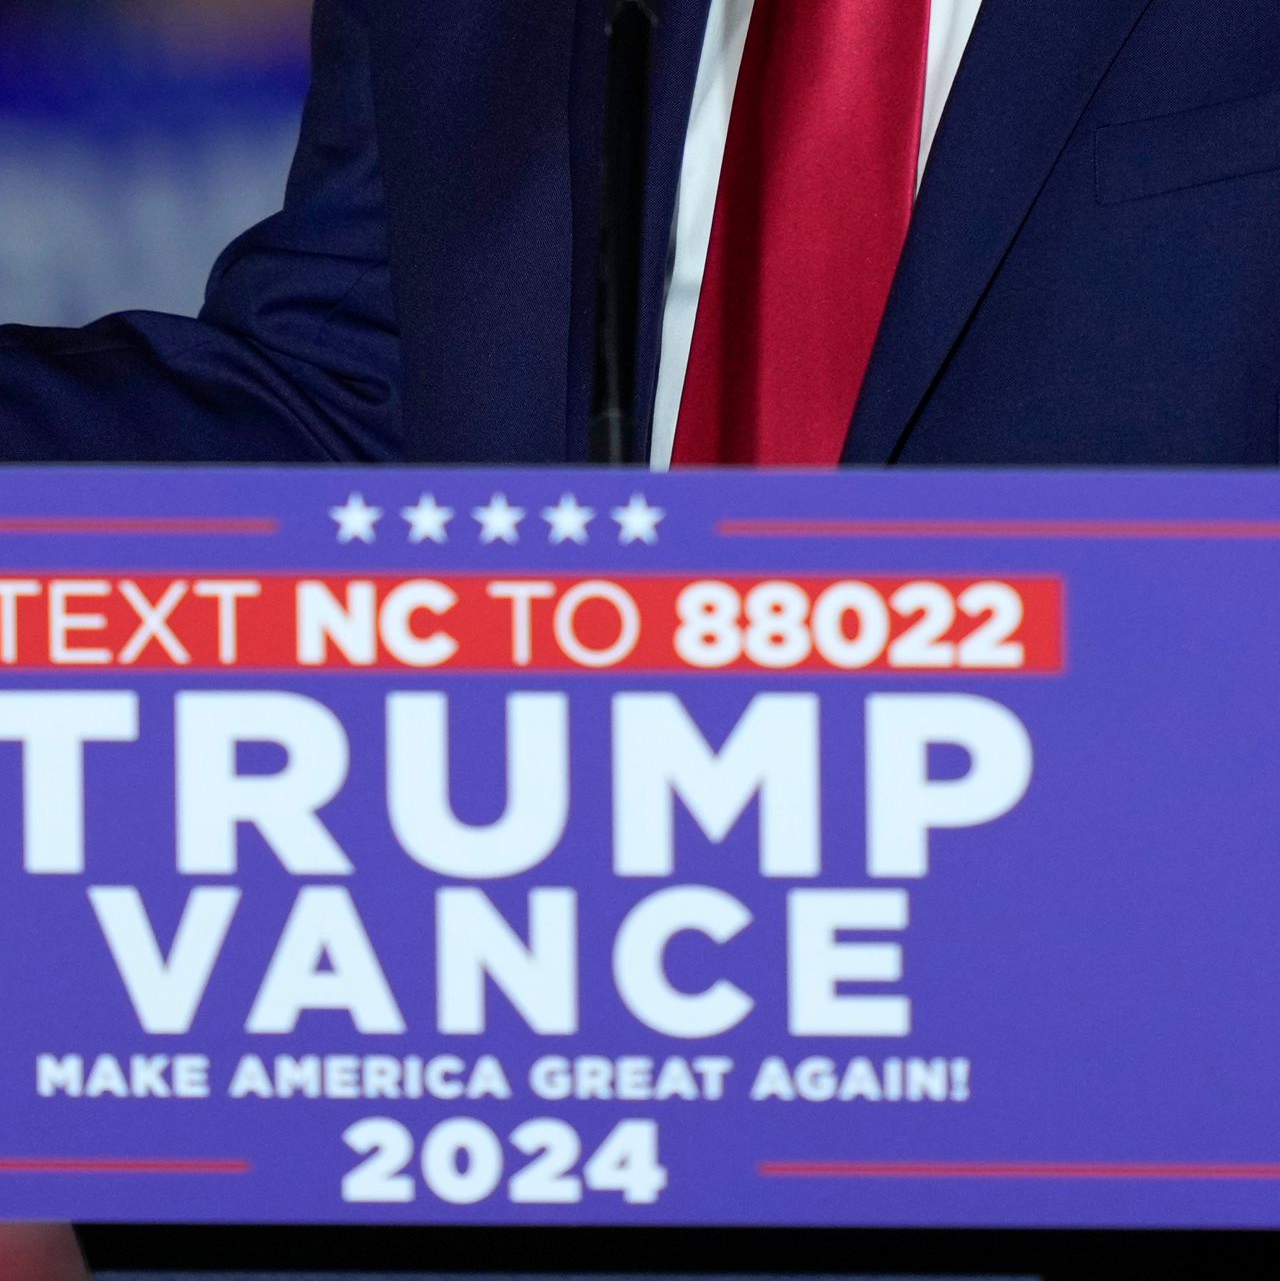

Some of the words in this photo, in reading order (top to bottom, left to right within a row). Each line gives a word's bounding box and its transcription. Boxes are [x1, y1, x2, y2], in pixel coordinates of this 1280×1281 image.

[294, 579, 459, 668] NC
[486, 580, 642, 668] TO
[672, 580, 1026, 670] 88022
[87, 884, 912, 1040] VANCE
[35, 1053, 210, 1099] MAKE
[228, 1054, 512, 1101] AMERICA
[529, 1055, 734, 1101] GREAT
[750, 1056, 971, 1103] AGAIN!
[340, 1116, 668, 1205] 2024
